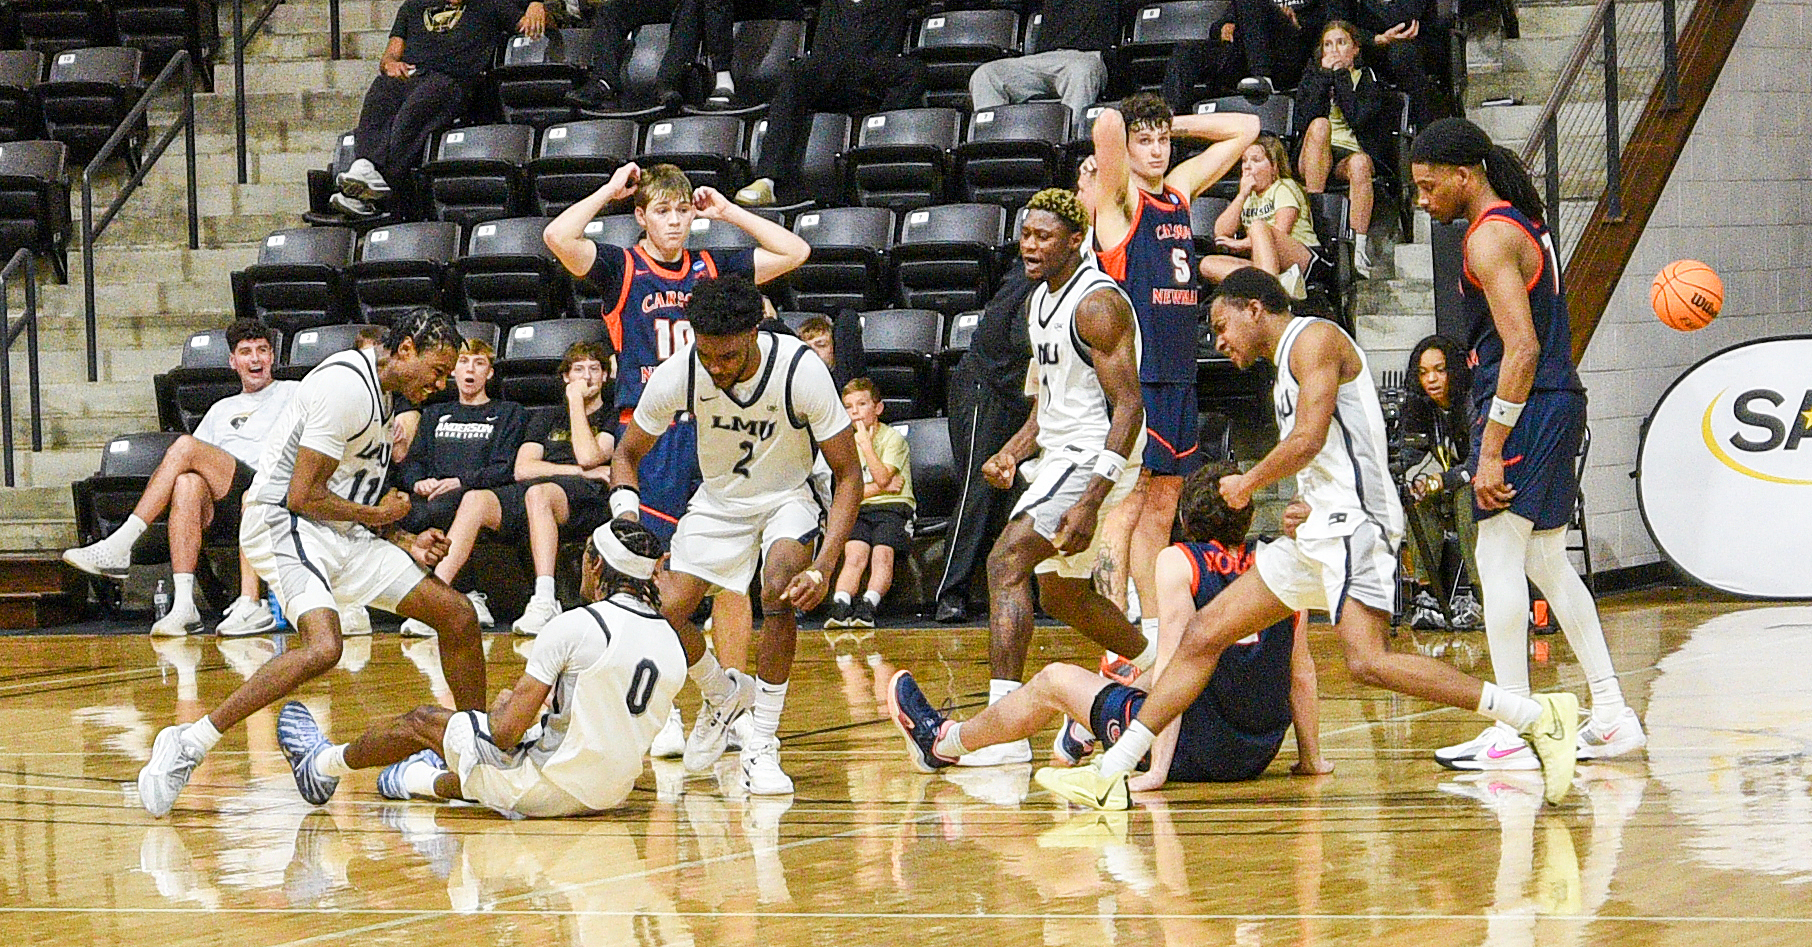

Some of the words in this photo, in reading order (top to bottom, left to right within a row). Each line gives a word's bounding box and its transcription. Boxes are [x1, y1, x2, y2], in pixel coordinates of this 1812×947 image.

[1171, 247, 1191, 284] 5
[654, 318, 696, 360] 10
[711, 415, 777, 441] LMU
[732, 440, 755, 478] 2
[626, 657, 660, 715] 0
